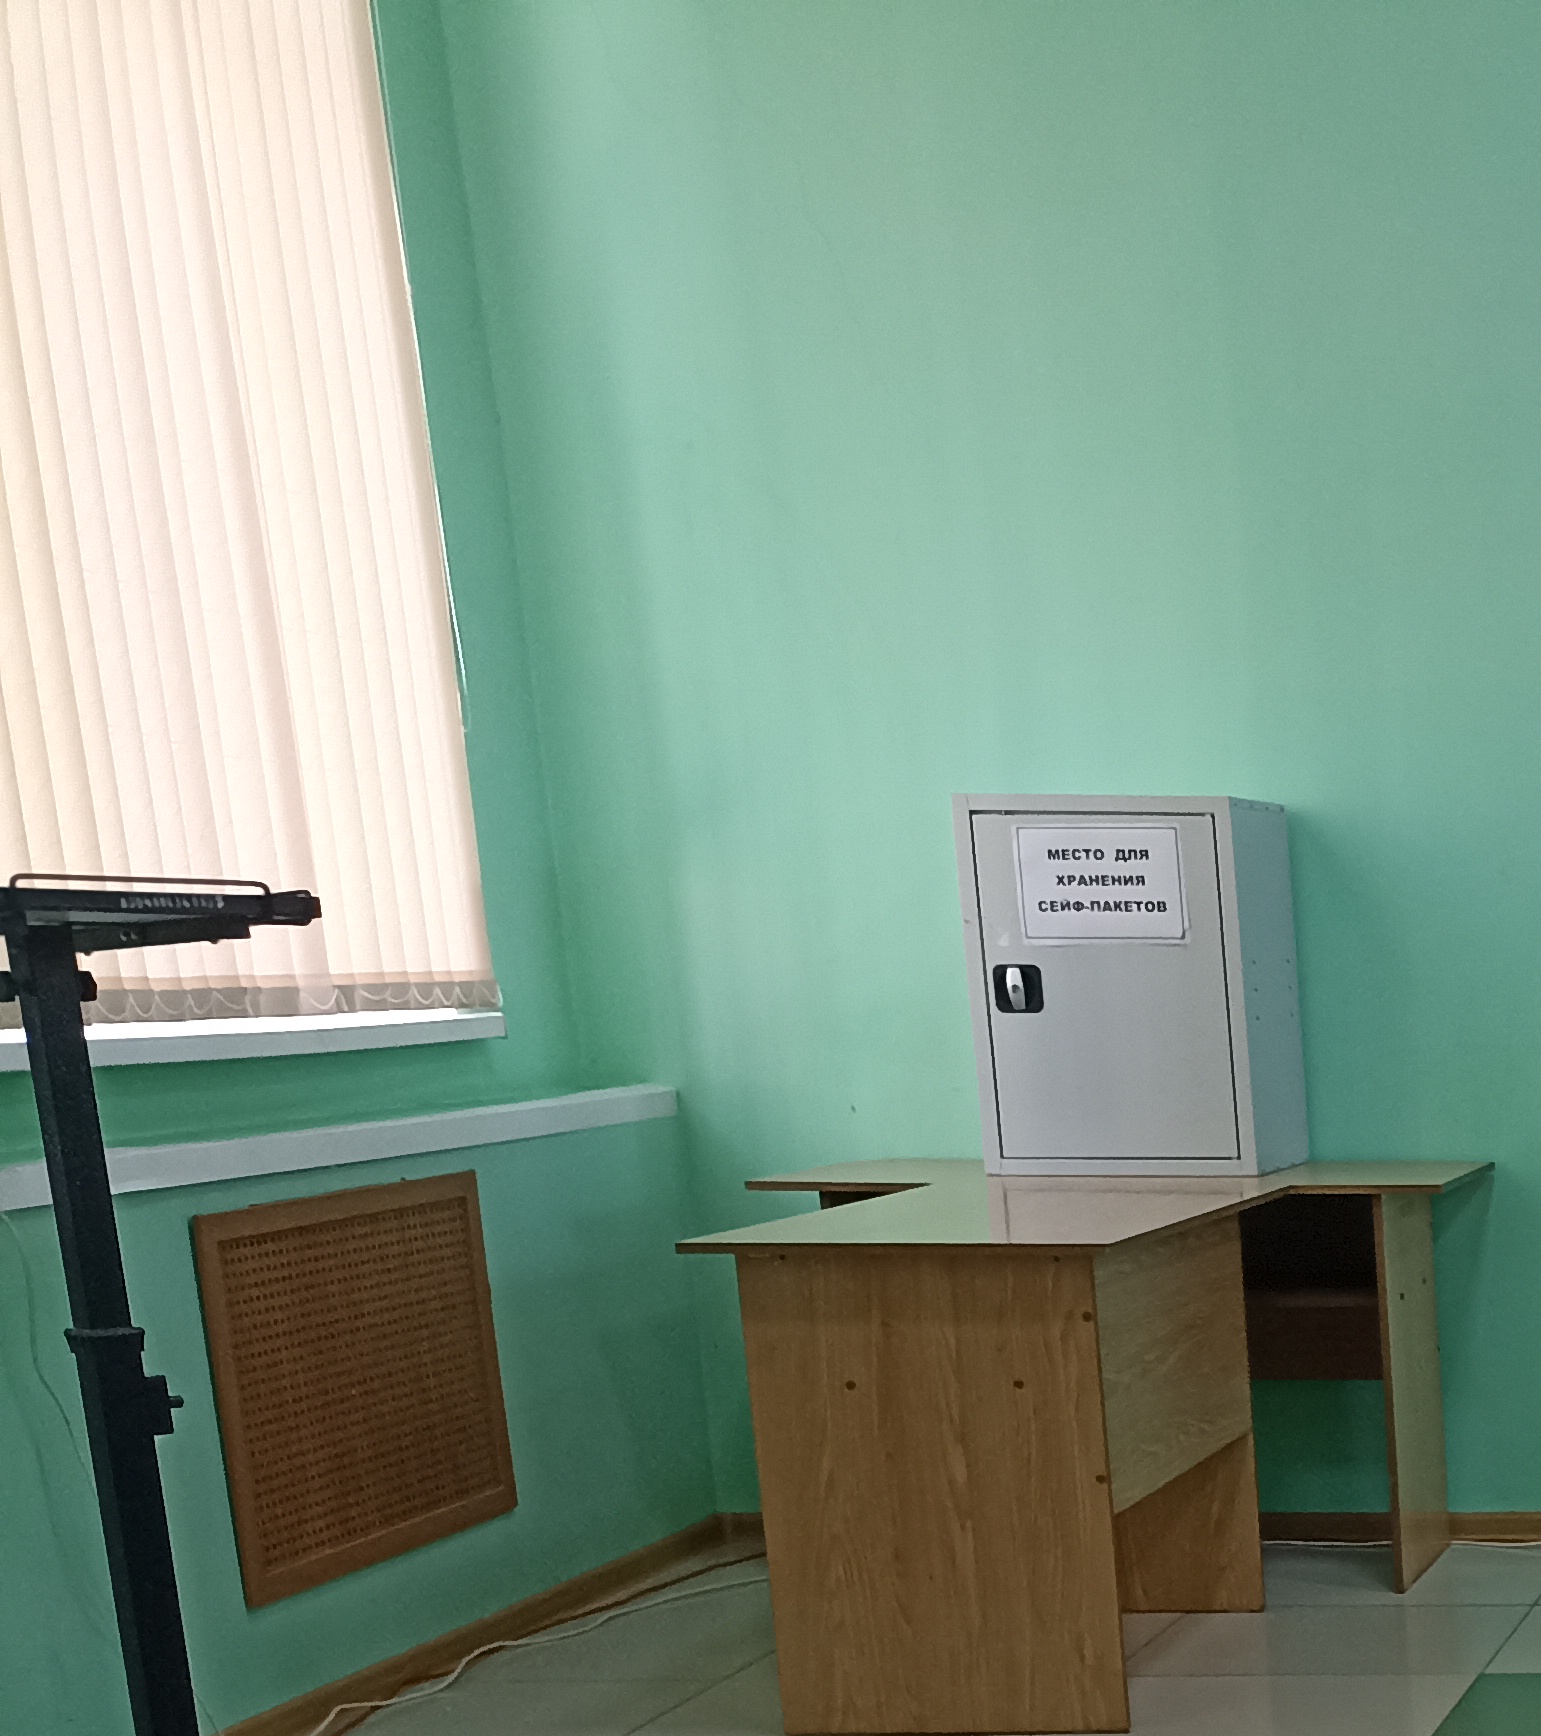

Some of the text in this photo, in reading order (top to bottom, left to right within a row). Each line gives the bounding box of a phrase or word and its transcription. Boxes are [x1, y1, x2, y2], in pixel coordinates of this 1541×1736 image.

[1047, 848, 1150, 862] МЕСТО ДЛЯ
[1056, 874, 1146, 887] ХРАНЕНИЯ
[1037, 898, 1168, 913] СЕЙФ-ПАКЕТОВ
